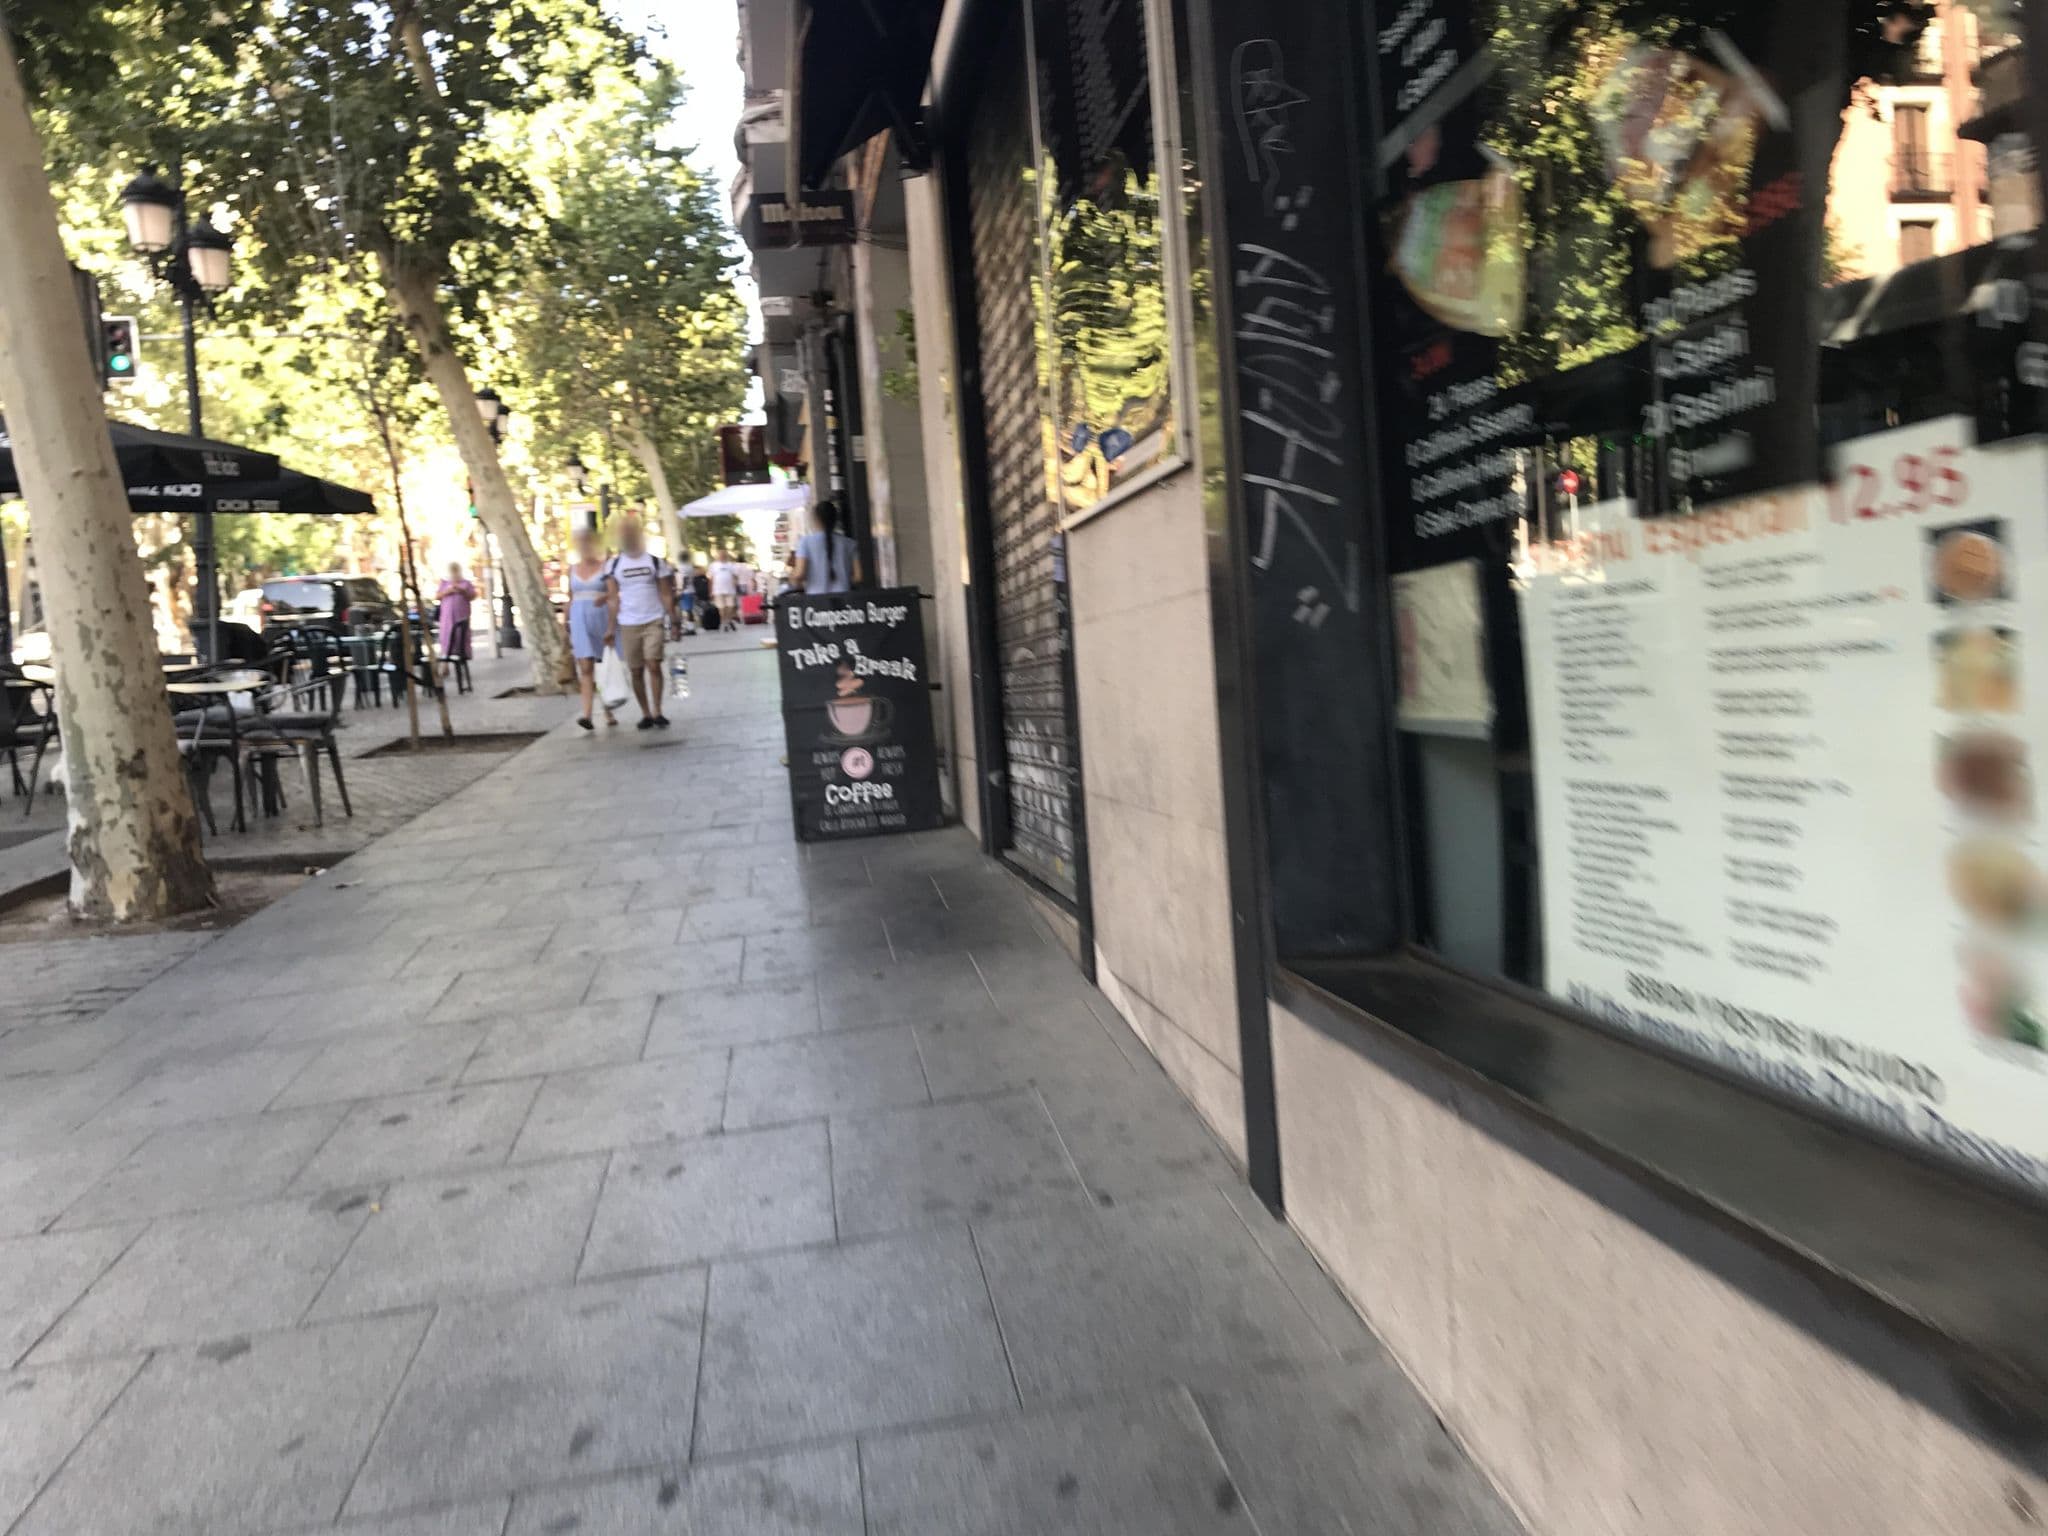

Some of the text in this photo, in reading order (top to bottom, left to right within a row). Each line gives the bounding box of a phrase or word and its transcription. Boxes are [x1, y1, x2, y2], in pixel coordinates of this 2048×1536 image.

[1826, 444, 1971, 525] 12.95
[788, 607, 803, 629] El
[866, 602, 908, 627] Burger
[788, 638, 861, 670] Take a
[853, 655, 918, 682] Break
